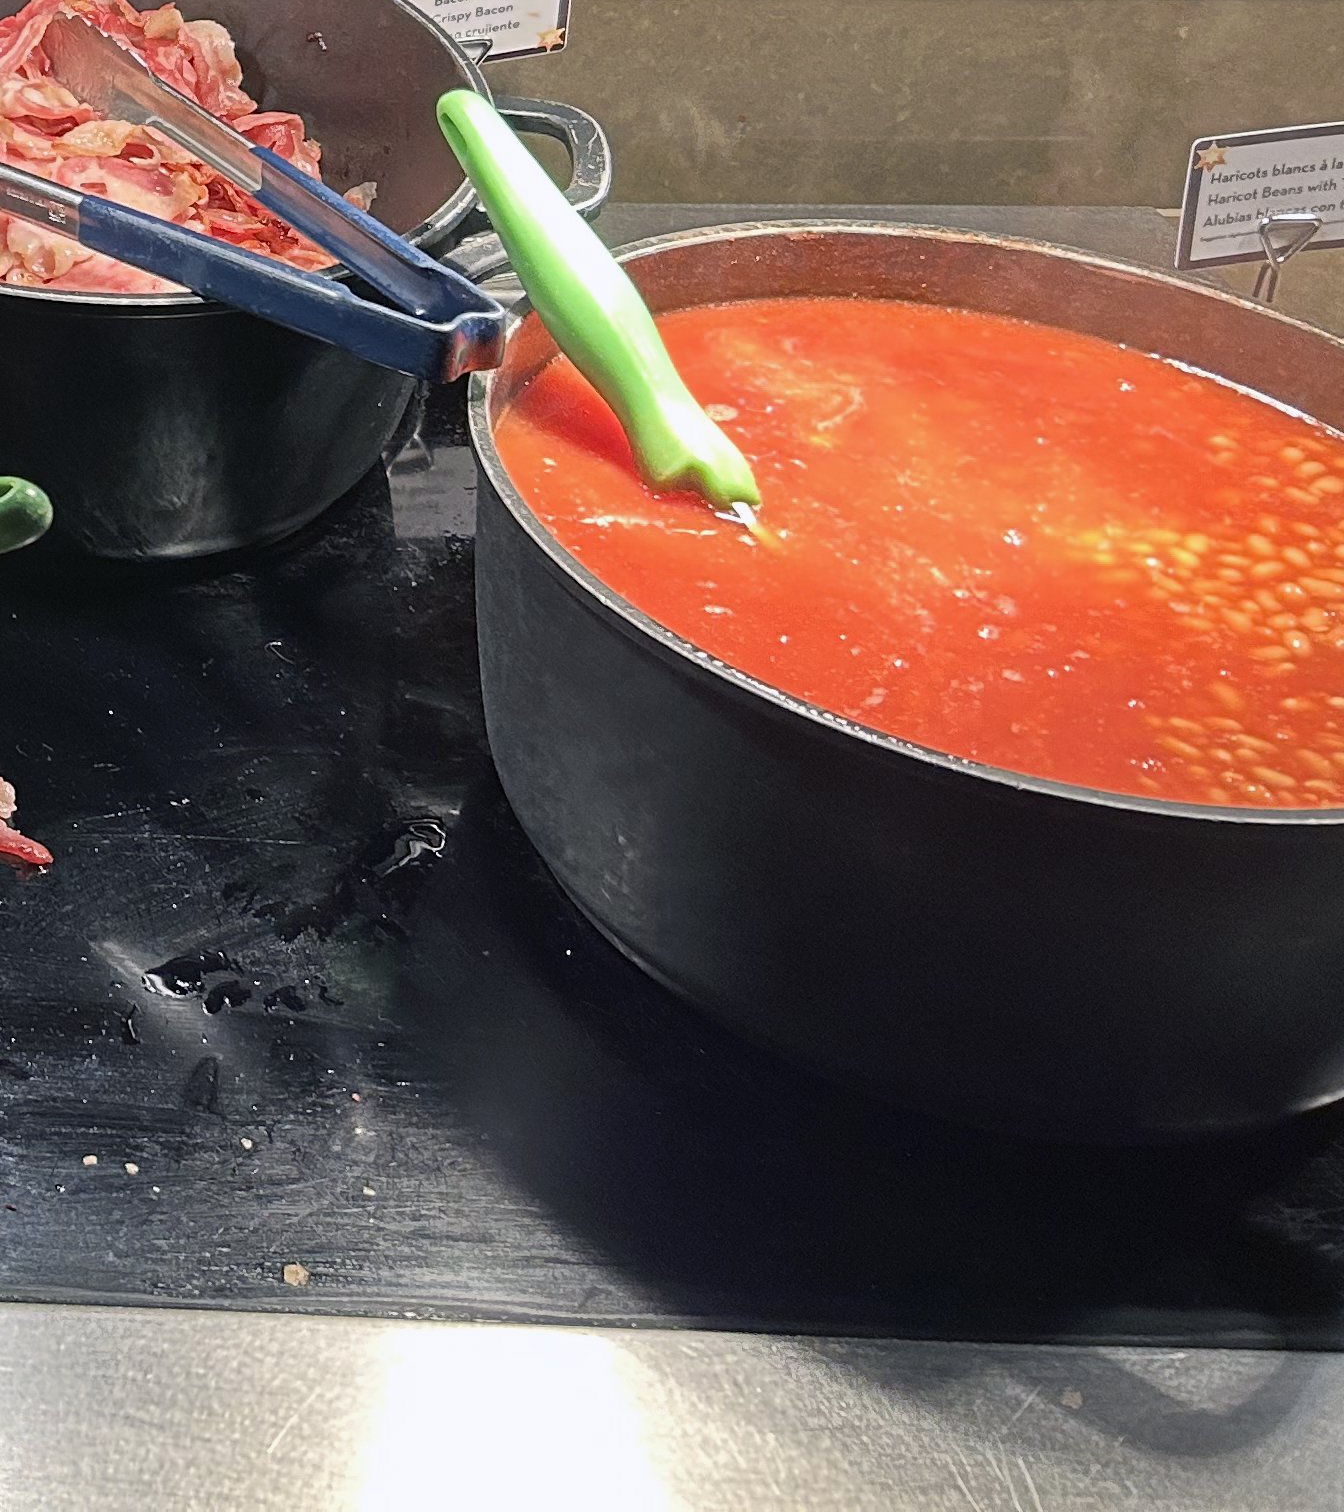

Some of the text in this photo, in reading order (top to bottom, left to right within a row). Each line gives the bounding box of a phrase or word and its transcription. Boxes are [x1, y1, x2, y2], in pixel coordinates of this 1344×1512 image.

[475, 4, 514, 18] Bacon
[465, 20, 520, 38] crujiente
[1210, 157, 1344, 184] Haricots blancs à la
[1208, 189, 1258, 206] Haricot
[1261, 186, 1304, 199] Beans
[1307, 179, 1337, 192] with
[1203, 212, 1252, 228] Alubias
[1310, 203, 1336, 213] con
